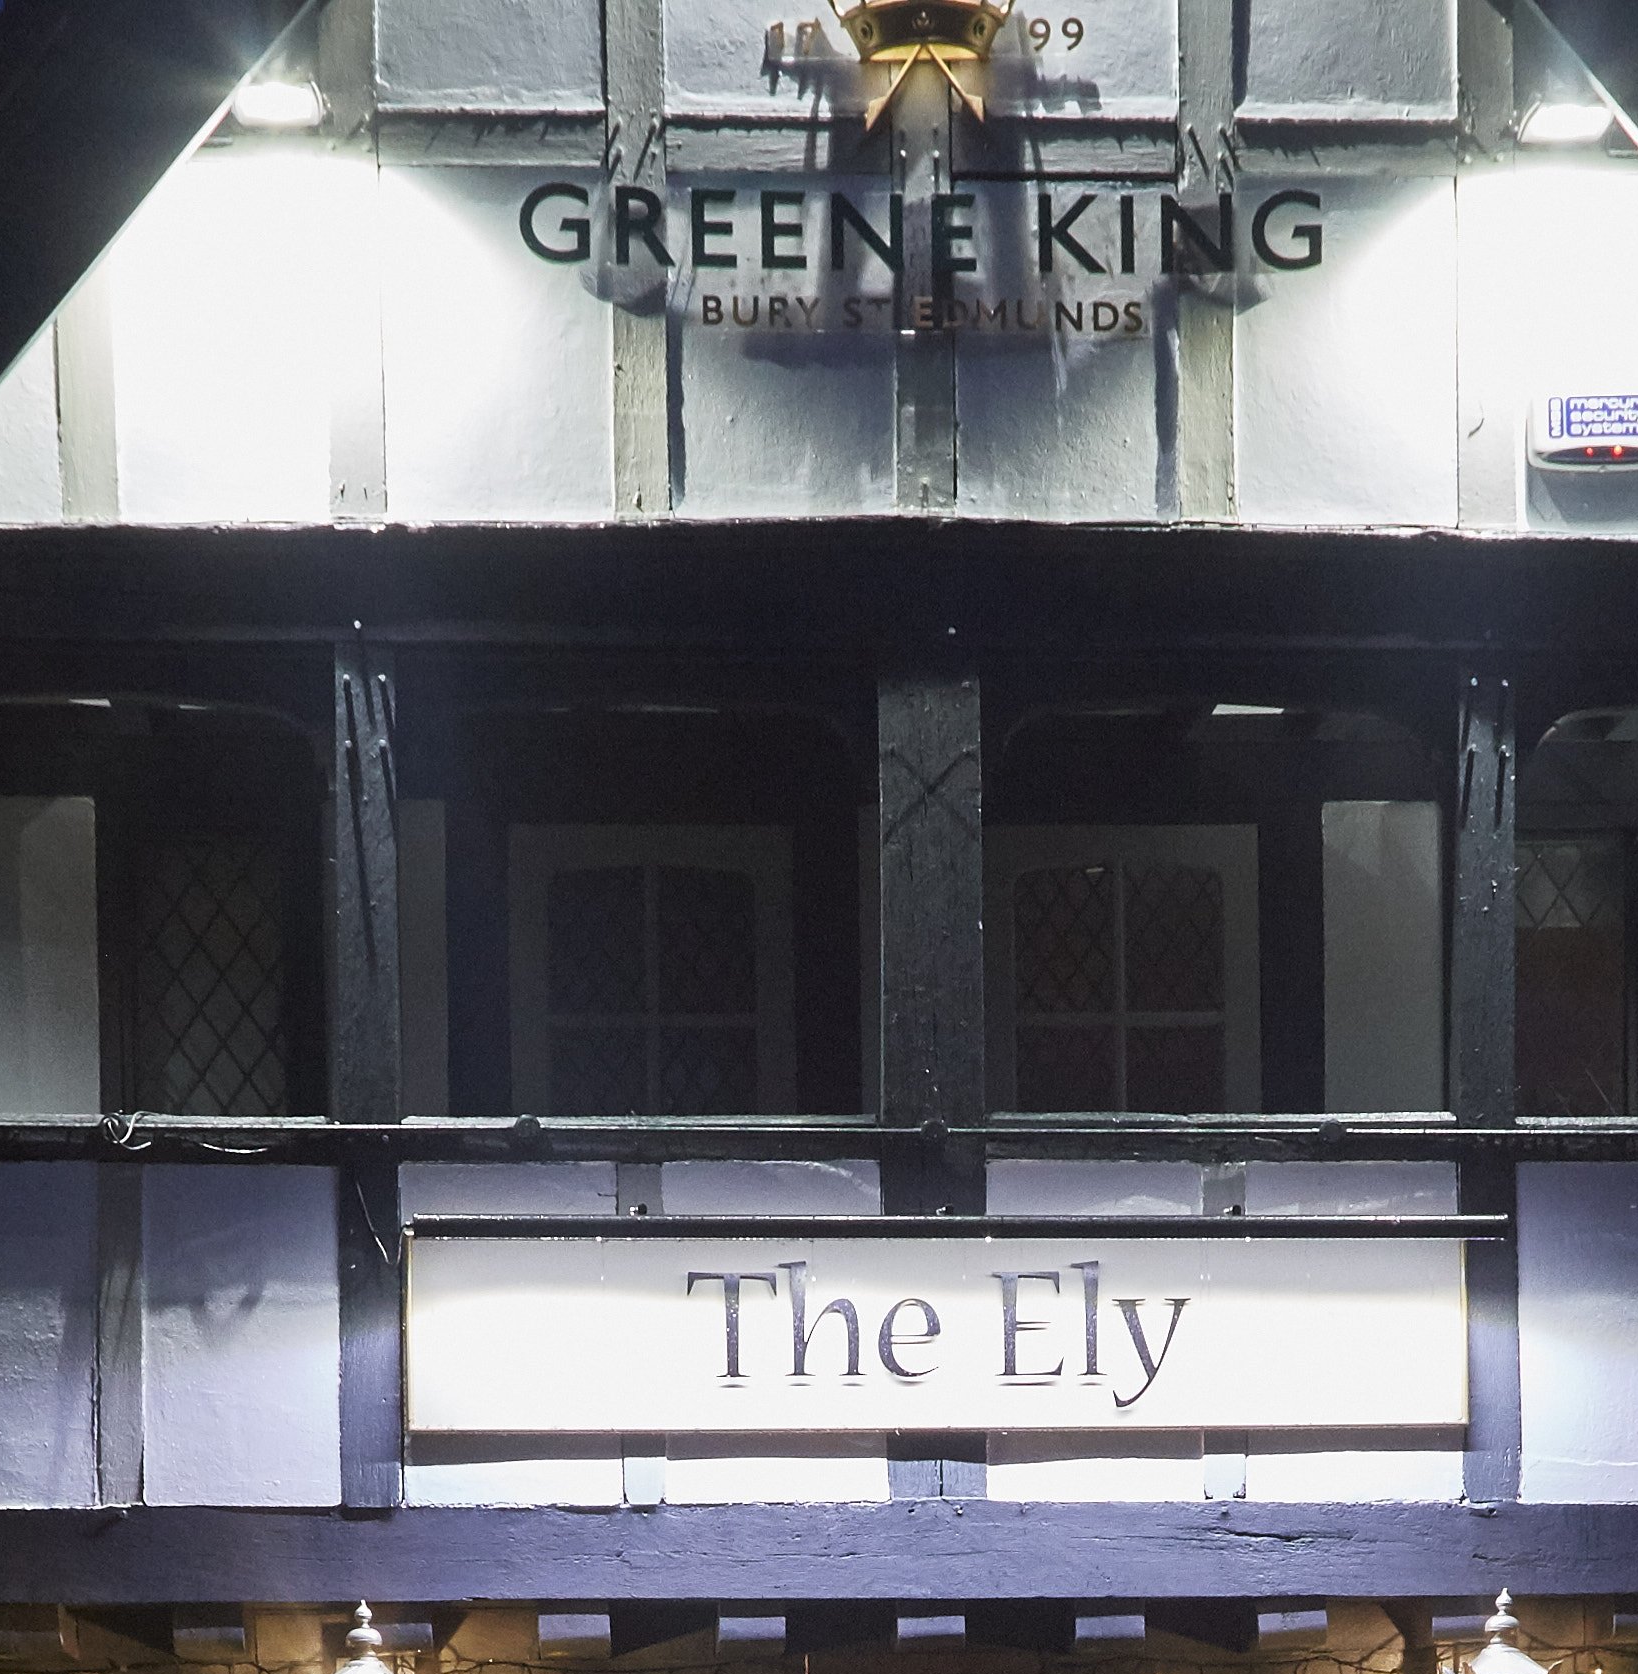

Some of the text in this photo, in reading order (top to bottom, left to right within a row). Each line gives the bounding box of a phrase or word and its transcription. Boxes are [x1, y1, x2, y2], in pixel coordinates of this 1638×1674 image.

[1029, 17, 1084, 51] 99
[518, 181, 1323, 274] GREENE KING
[702, 294, 821, 328] BURY
[913, 295, 1144, 332] EDMUNDS
[687, 1260, 1191, 1408] The Ely
